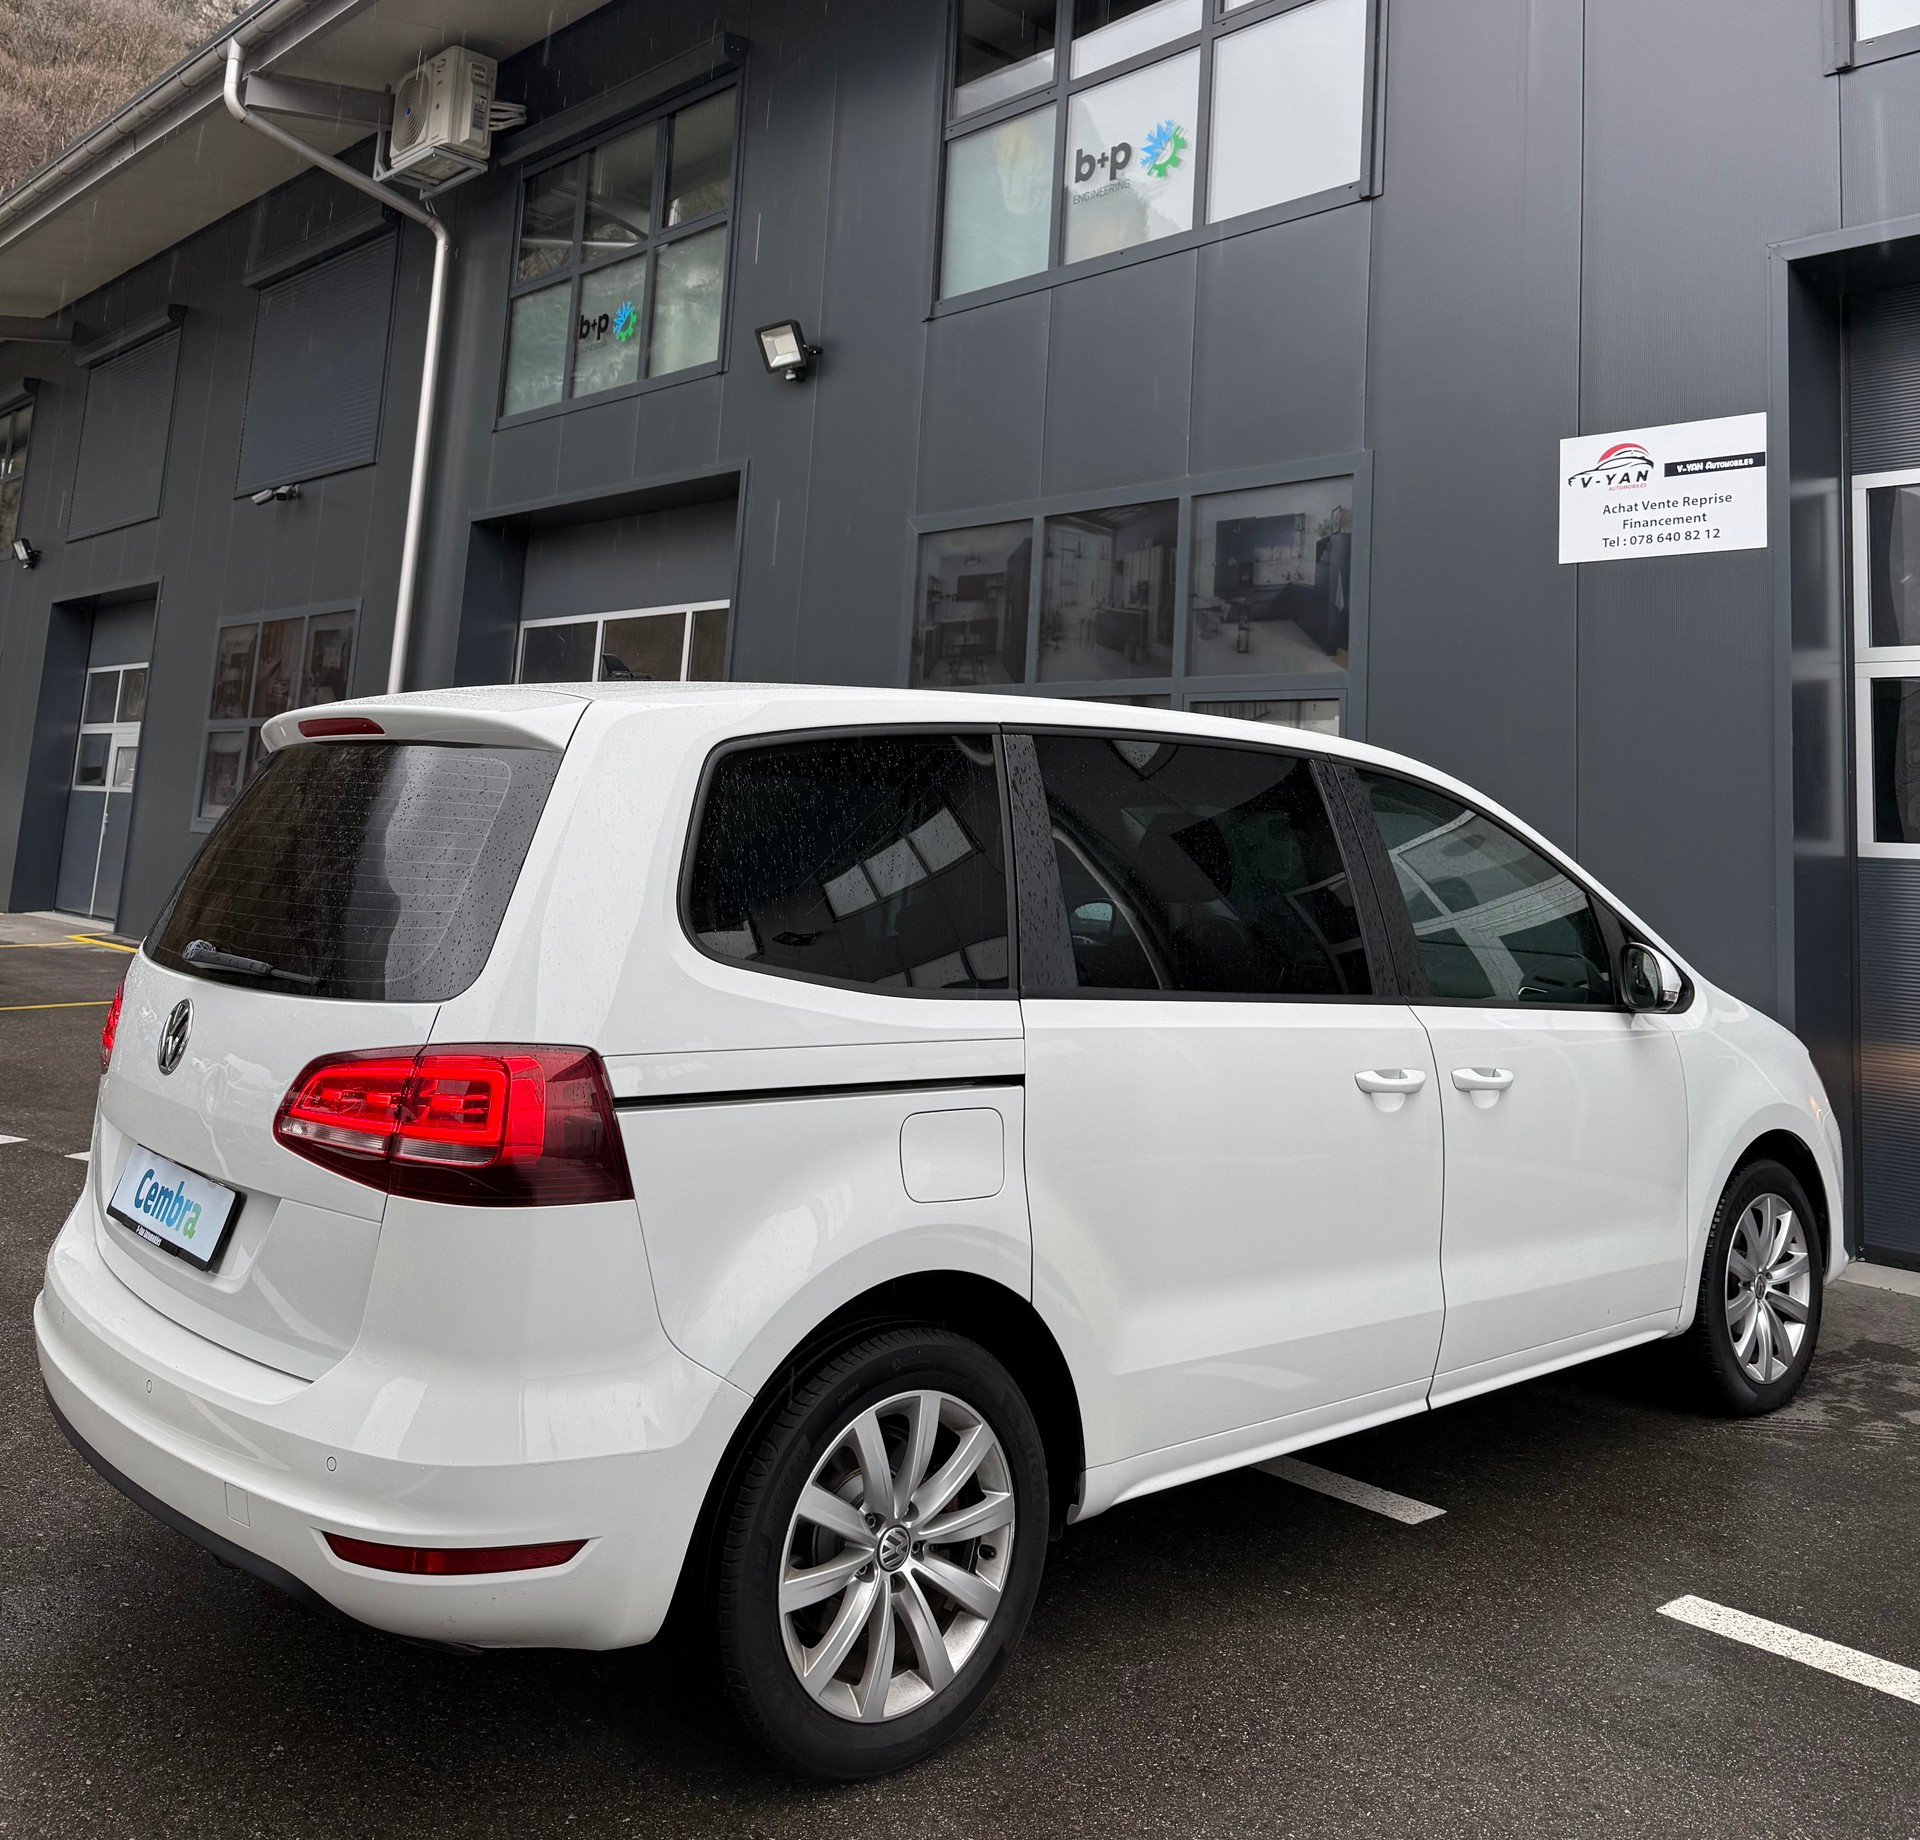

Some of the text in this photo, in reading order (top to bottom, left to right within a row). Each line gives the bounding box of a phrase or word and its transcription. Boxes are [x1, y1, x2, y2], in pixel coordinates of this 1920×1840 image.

[1072, 178, 1131, 205] ENGINEERING
[1608, 482, 1647, 492] AUTOMOBILES
[1602, 493, 1733, 515] Achat Vente Reprise
[1622, 512, 1708, 530] Financement
[1629, 534, 1653, 546] 078
[1656, 531, 1681, 543] 640
[1684, 530, 1701, 541] 82
[1704, 528, 1721, 539] 12
[134, 1168, 202, 1239] Cembra
